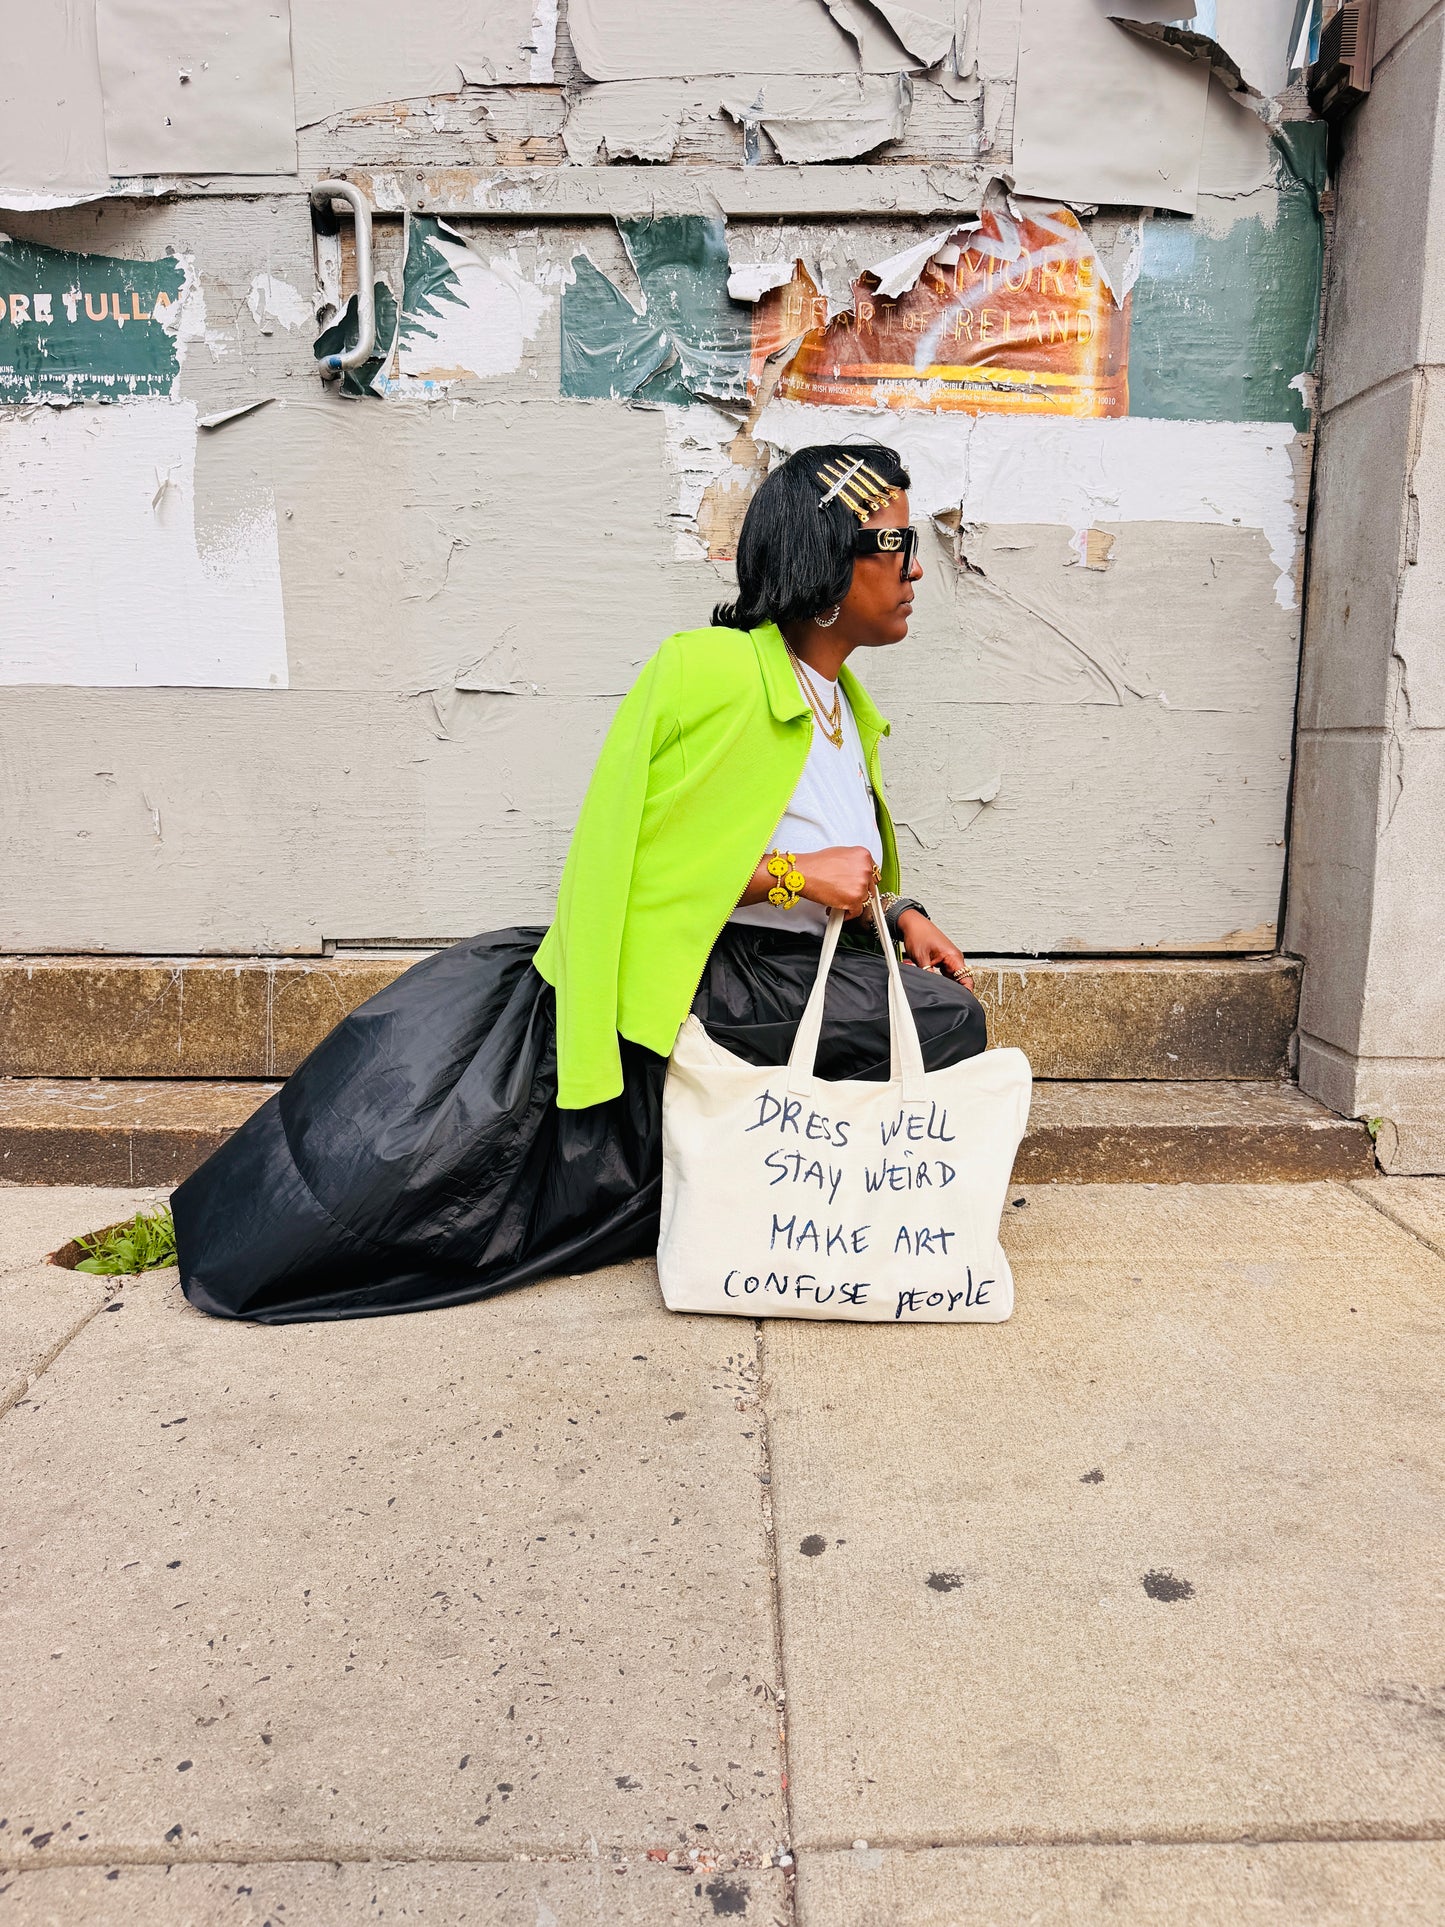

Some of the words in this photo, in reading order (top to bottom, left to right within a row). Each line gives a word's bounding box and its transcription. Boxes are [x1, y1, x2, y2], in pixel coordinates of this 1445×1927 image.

[787, 295, 897, 337] HEART
[940, 307, 1096, 344] IRELAND
[745, 1089, 851, 1147] DRESS
[881, 1101, 956, 1146] WELL
[764, 1148, 842, 1204] STAY
[865, 1150, 956, 1193] WEIRD
[770, 1213, 872, 1256] MAKE
[895, 1225, 955, 1256] ART
[724, 1270, 871, 1305] CONFUSE
